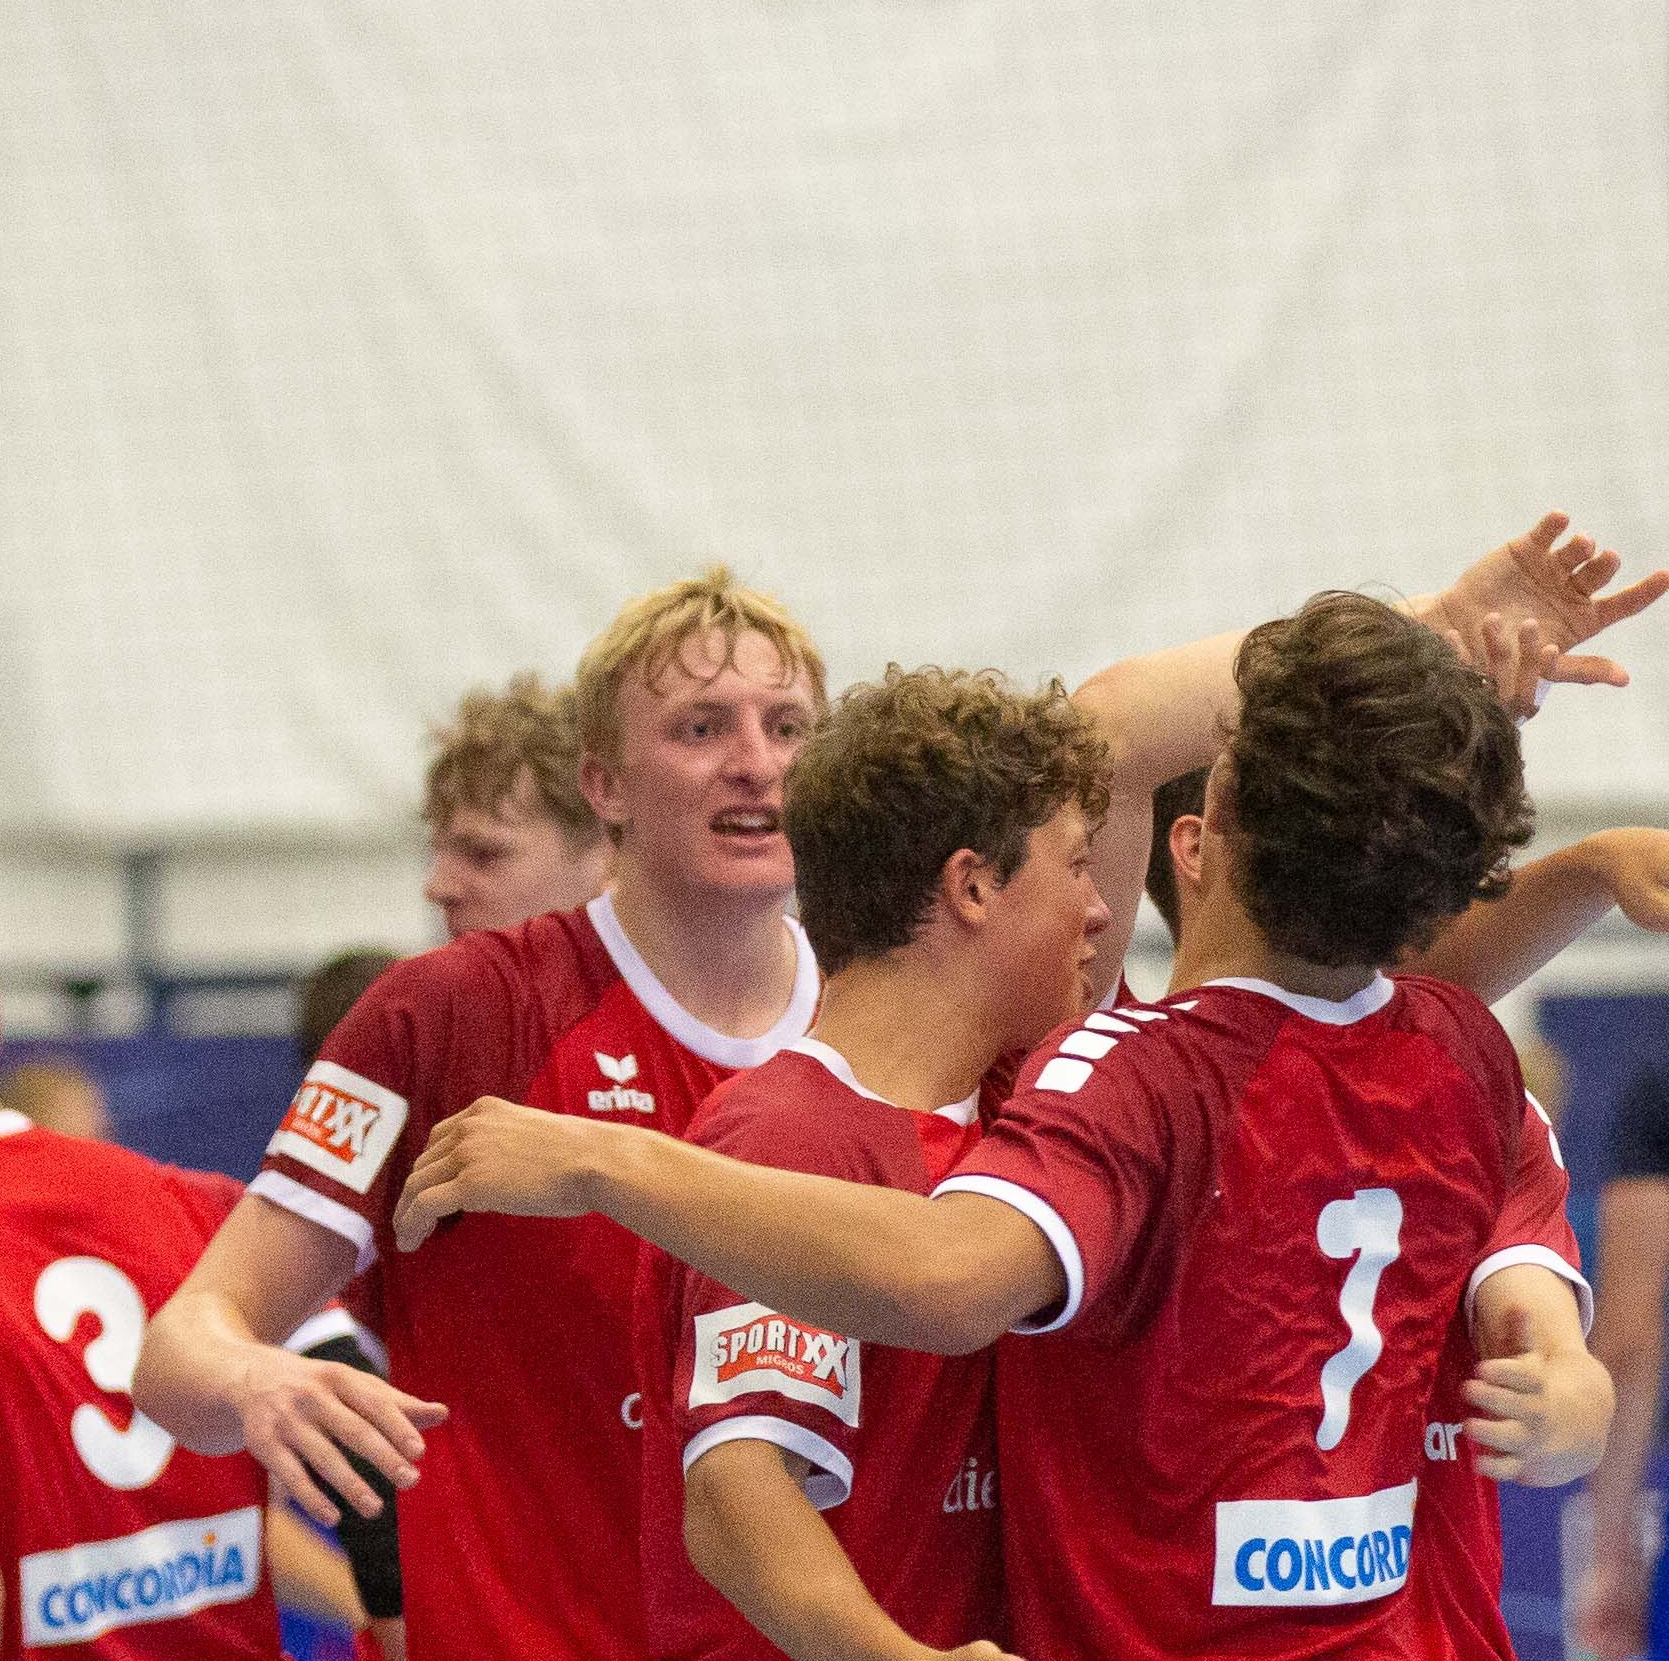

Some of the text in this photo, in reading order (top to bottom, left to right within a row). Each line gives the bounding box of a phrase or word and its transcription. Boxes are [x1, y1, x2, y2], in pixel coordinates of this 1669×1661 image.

[34, 1255, 175, 1491] 3
[37, 1531, 245, 1629] CONCORDIA
[1234, 1524, 1411, 1592] CONCORD
